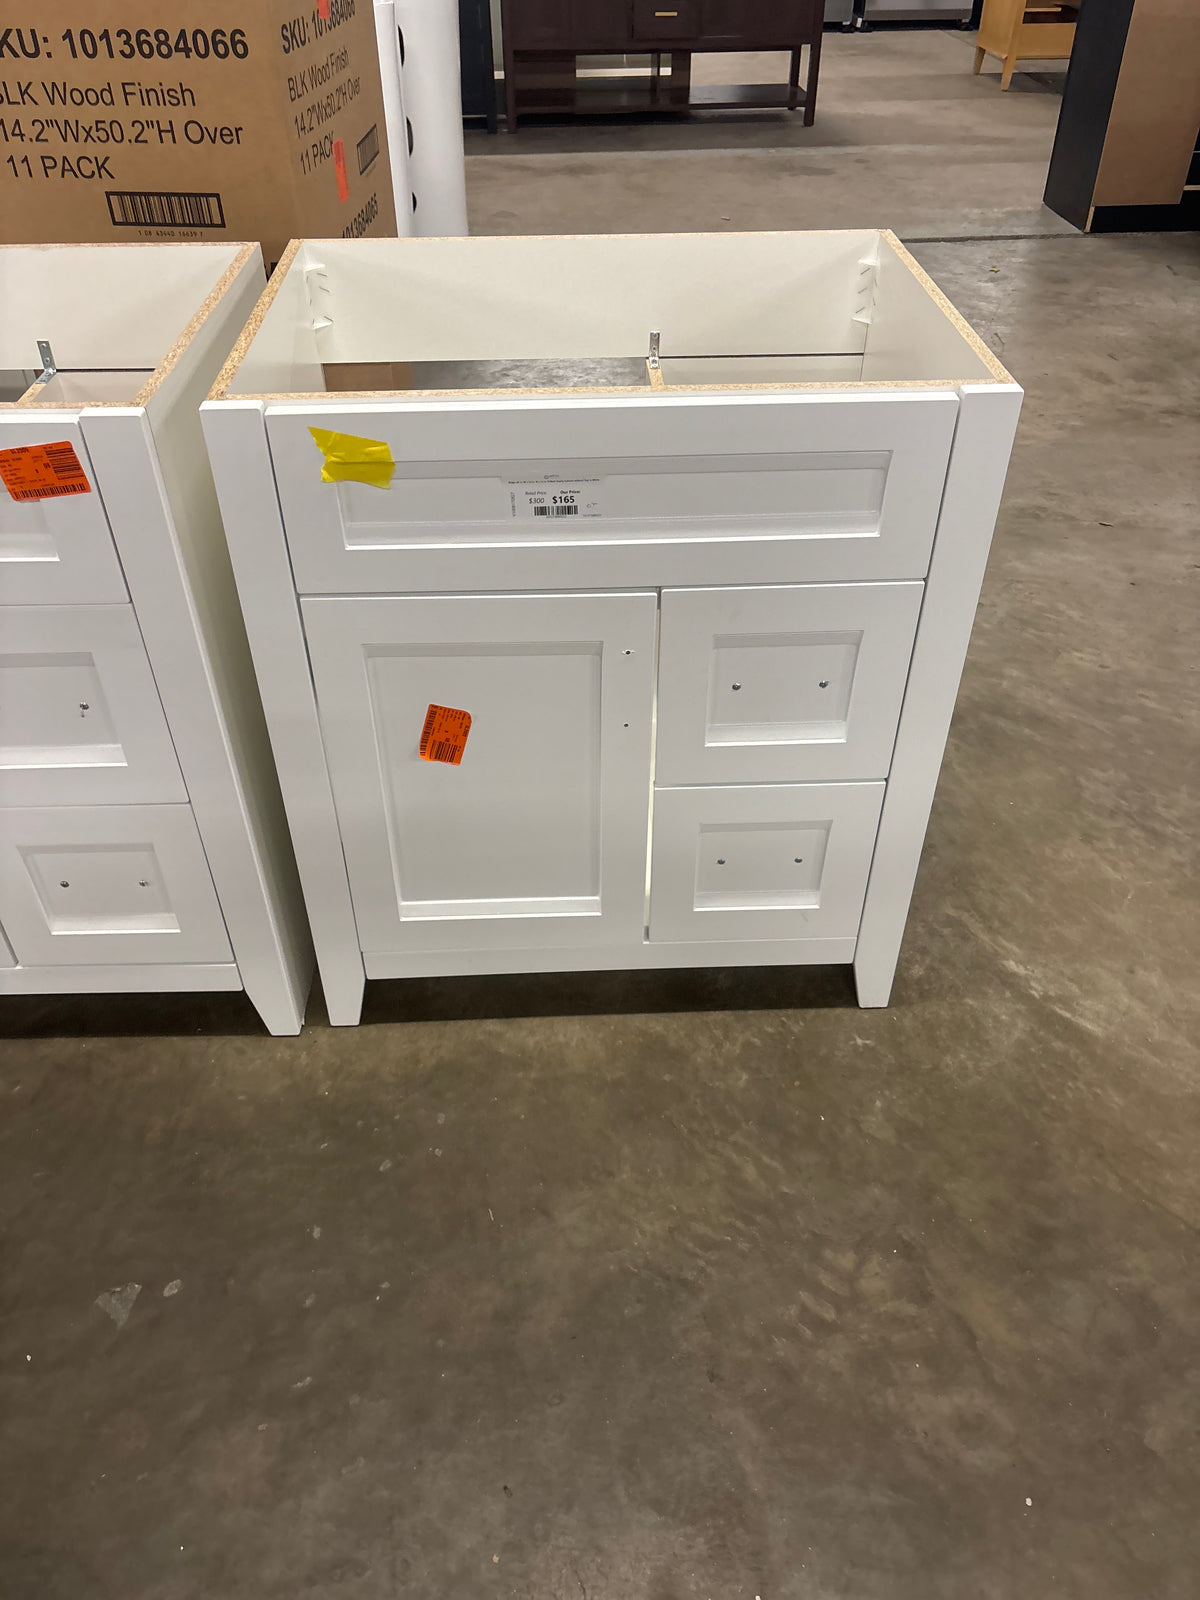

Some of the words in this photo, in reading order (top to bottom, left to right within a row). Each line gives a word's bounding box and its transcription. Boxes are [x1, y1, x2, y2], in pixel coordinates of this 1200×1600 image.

[0, 28, 53, 59] KU:
[62, 28, 249, 60] 1013684066
[281, 16, 311, 54] SKU:
[288, 70, 309, 102] BLK
[308, 56, 331, 90] Wood
[330, 45, 350, 76] Finish
[41, 81, 115, 107] Wood
[121, 82, 196, 107] Finish
[184, 120, 243, 145] Over
[7, 155, 33, 178] 11
[40, 155, 116, 180] PACK
[300, 148, 312, 176] 11
[552, 495, 575, 504] $165
